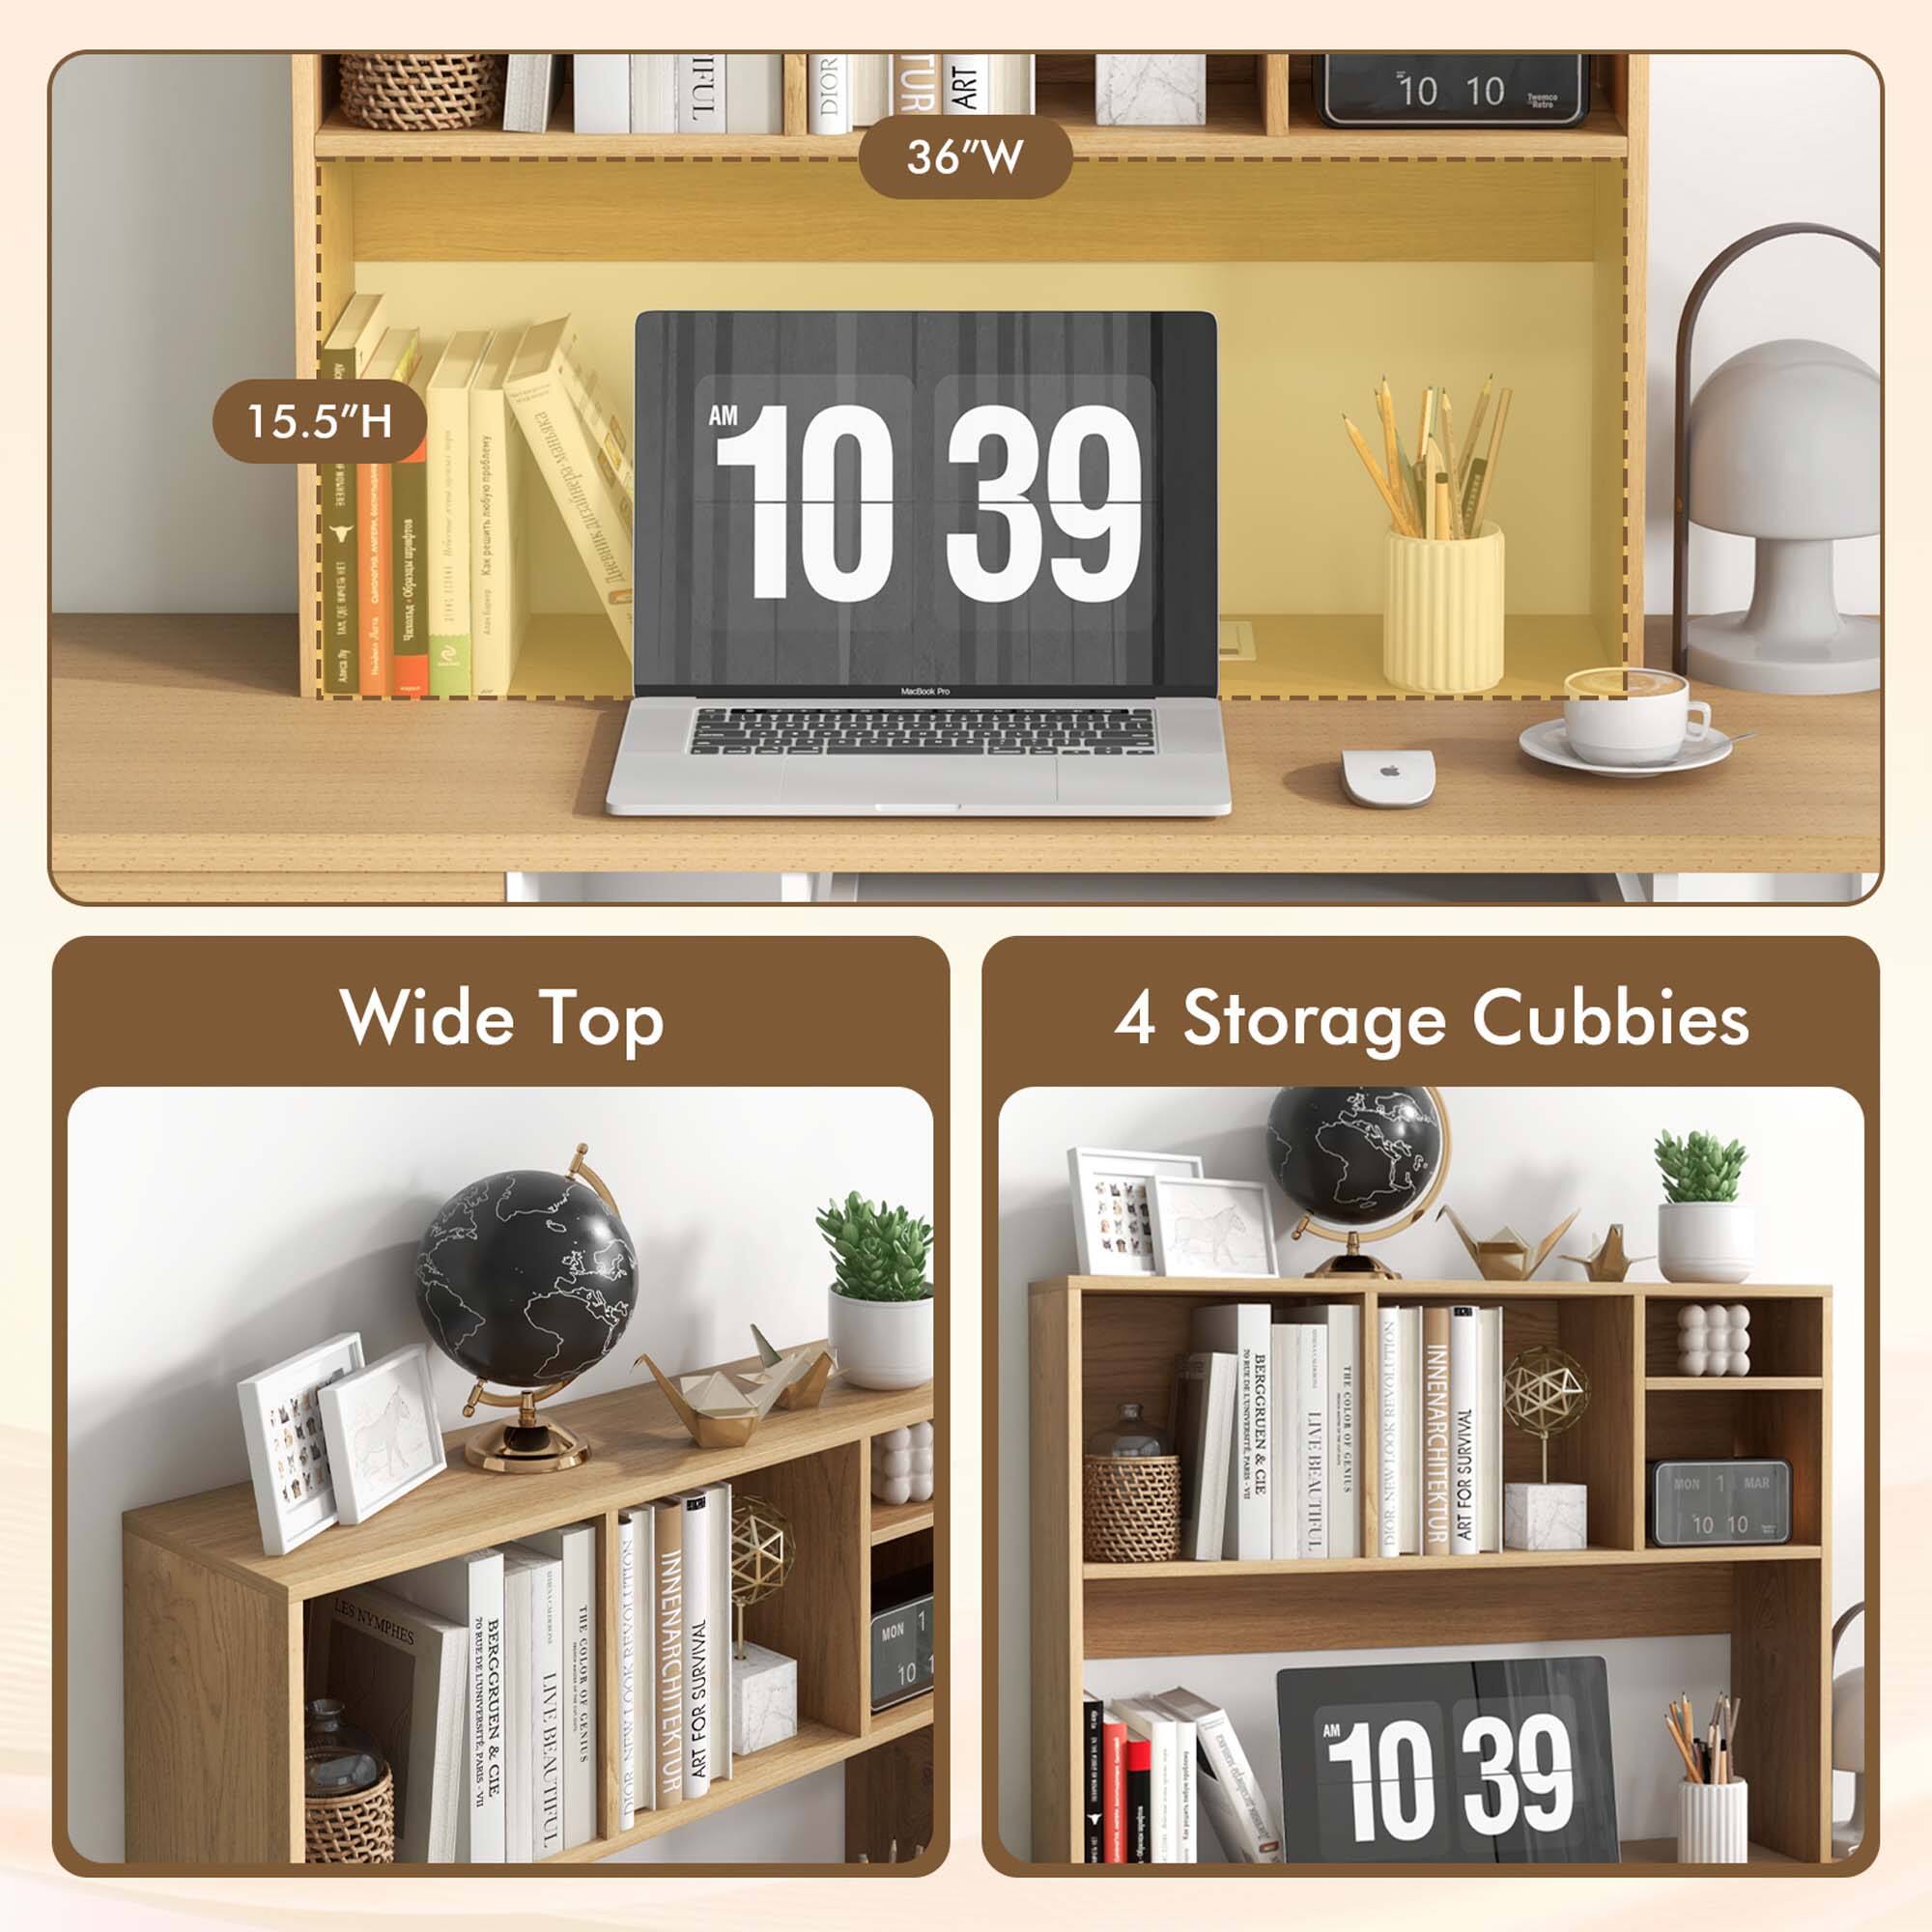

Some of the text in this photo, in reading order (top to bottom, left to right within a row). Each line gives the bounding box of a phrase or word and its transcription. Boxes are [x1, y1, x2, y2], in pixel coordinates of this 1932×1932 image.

[952, 67, 976, 109] ART
[1400, 76, 1505, 106] 10 10
[708, 405, 738, 425] AM
[480, 436, 494, 576] Как решить любую проблему
[717, 405, 1142, 603] 10 39
[901, 687, 951, 696] MacBook Pro
[1243, 1379, 1250, 1392] DE
[1384, 1321, 1396, 1417] REVOLUTION
[1255, 1354, 1266, 1495] BERGGRUEN & CIE
[1344, 1434, 1351, 1447] OF
[1428, 1344, 1448, 1544] INNENARCHITEKTUR
[1308, 1411, 1322, 1551] LIVE BEAUTIFUL
[1344, 1452, 1352, 1493] GENIUS
[1384, 1469, 1396, 1501] NEW
[1457, 1408, 1471, 1541] ART FOR SURVIVAL
[1745, 1476, 1771, 1489] MAR
[1693, 1516, 1715, 1534] 10
[1727, 1516, 1748, 1534] 10
[334, 1597, 414, 1646] LES NYMPHES
[475, 1617, 483, 1630] 70
[882, 1610, 925, 1641] MON 1
[475, 1632, 484, 1655] RUE
[475, 1656, 484, 1672] DE
[579, 1605, 589, 1763] THE COLOR OF GENIUS
[661, 1548, 683, 1794] INNENARCHITEKTUR
[897, 1662, 916, 1685] 10
[488, 1618, 500, 1798] BERGGRUEN & CIE
[692, 1619, 706, 1778] ART FOR SURVIVAL
[1323, 1723, 1341, 1737] AM
[475, 1752, 484, 1783] PARIS
[543, 1672, 558, 1849] LIVE BEAUTIFUL
[1328, 1713, 1574, 1842] 10 39
